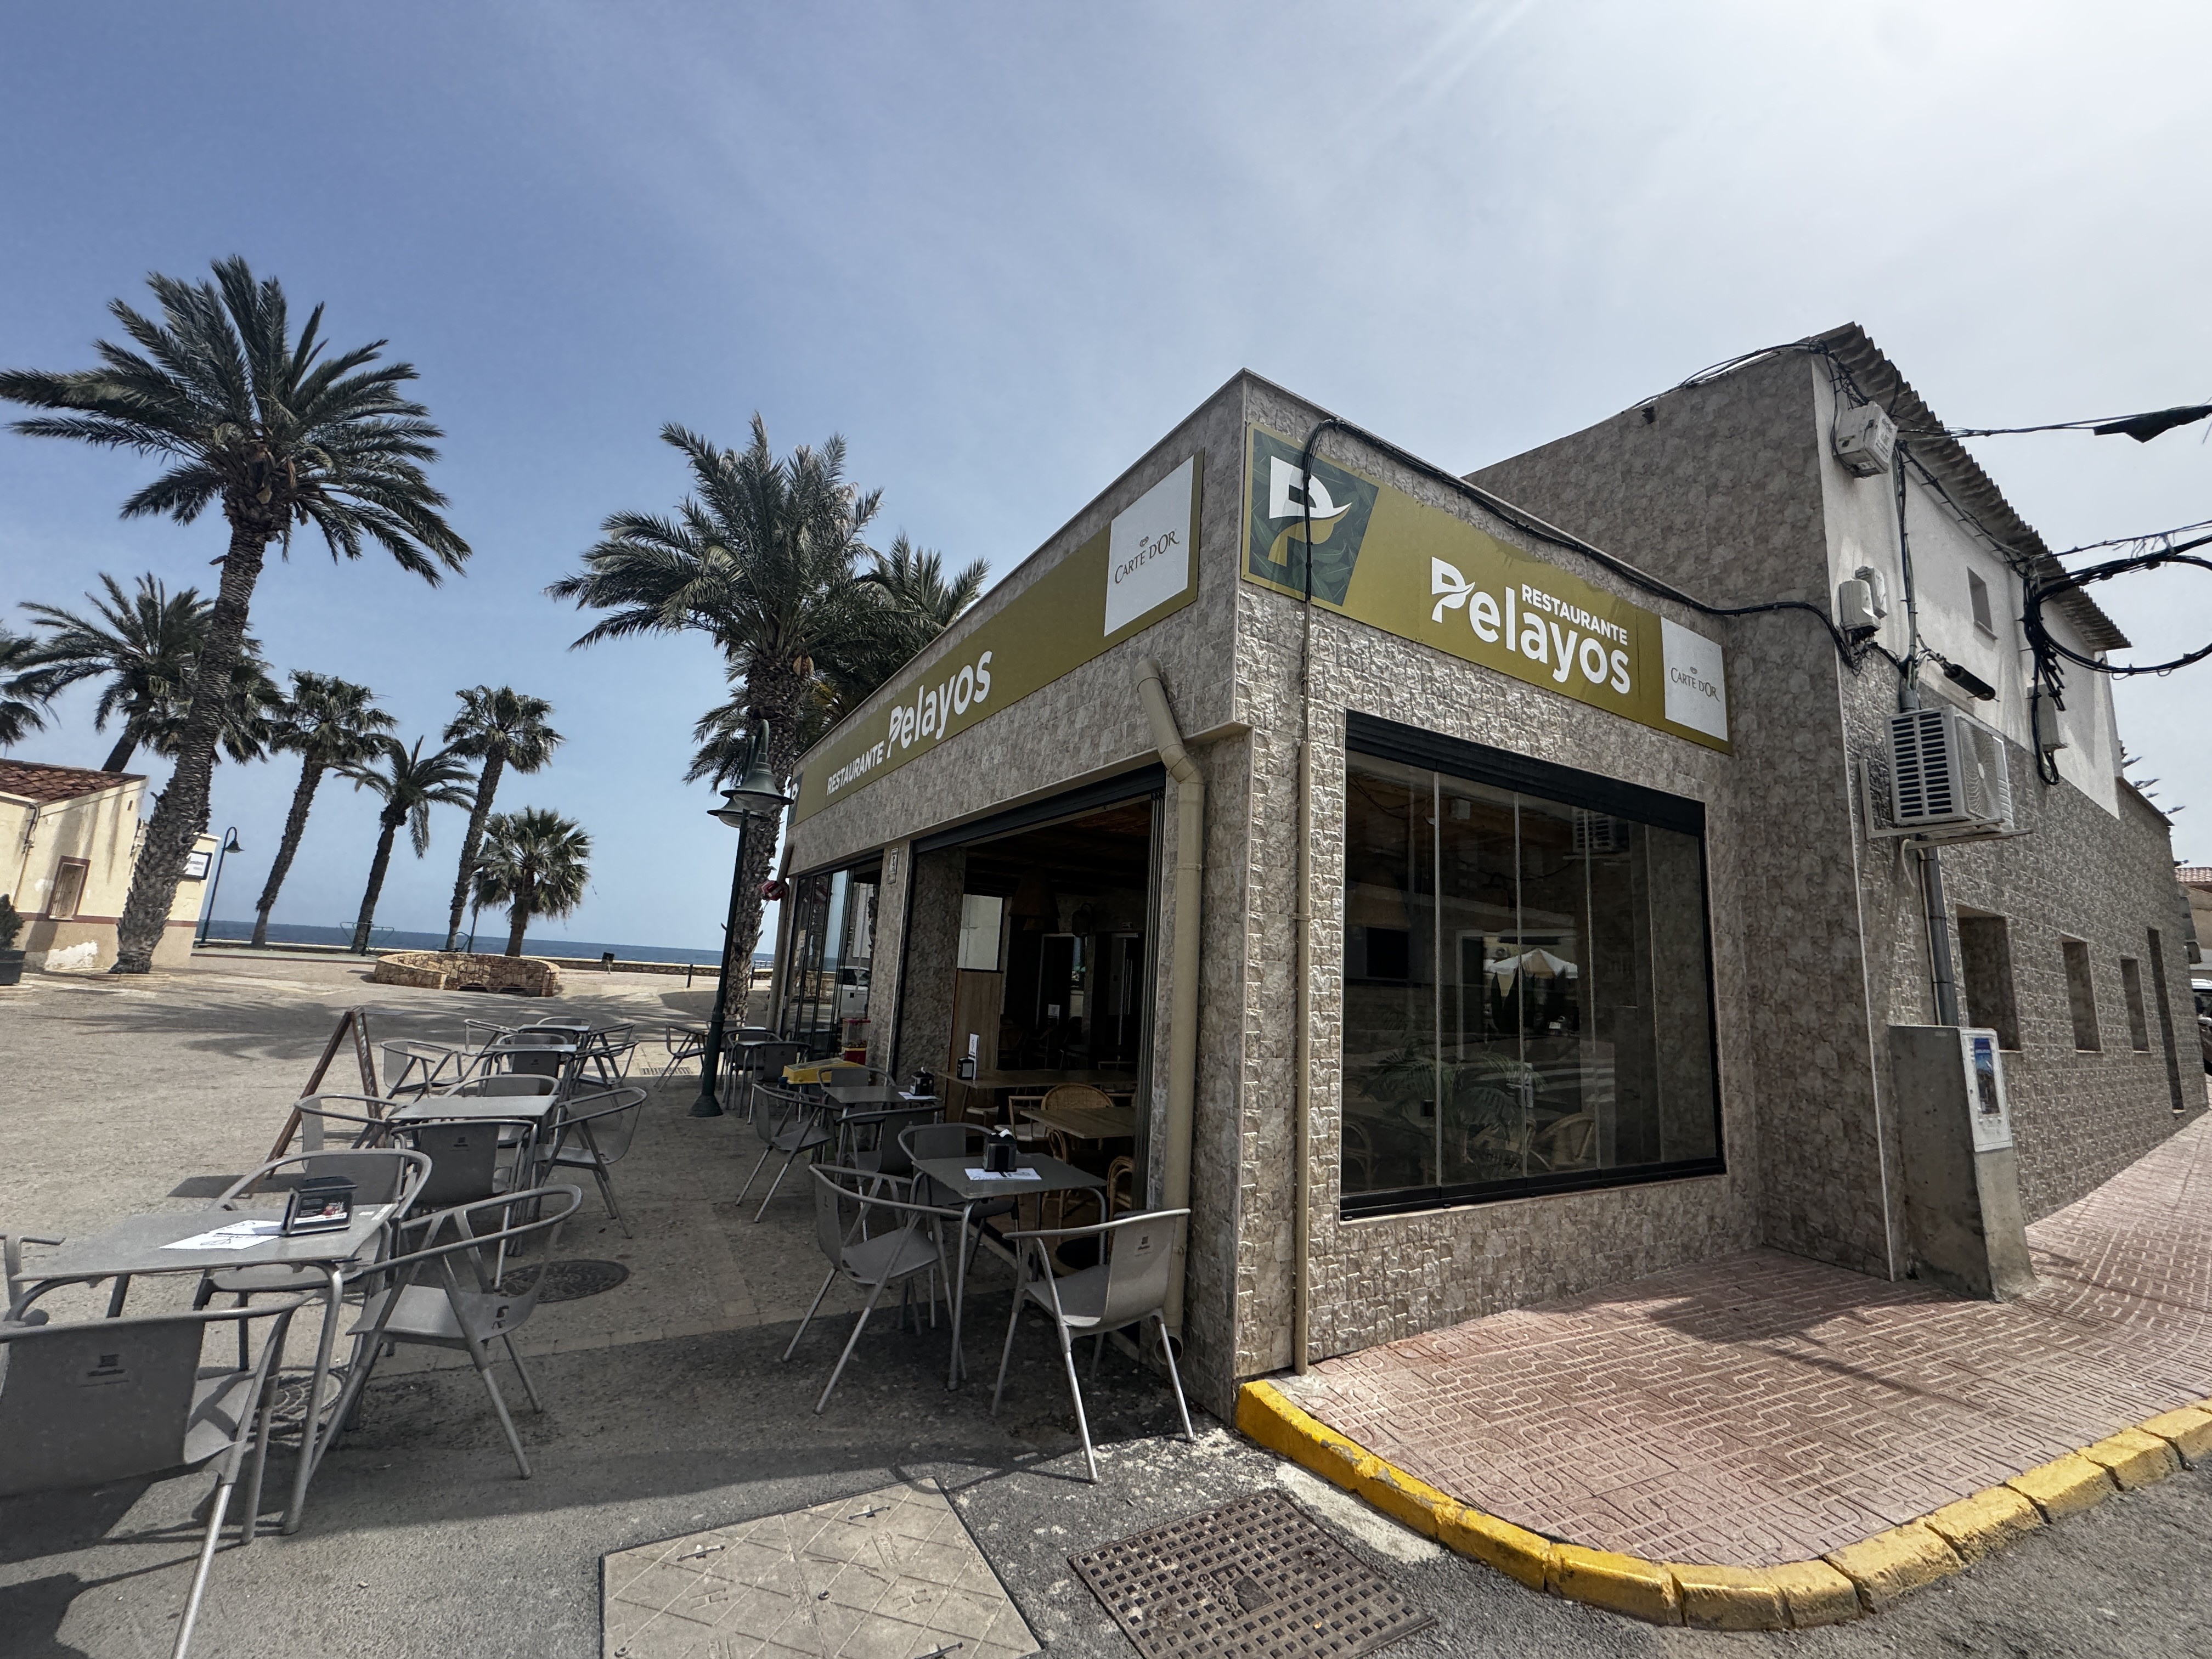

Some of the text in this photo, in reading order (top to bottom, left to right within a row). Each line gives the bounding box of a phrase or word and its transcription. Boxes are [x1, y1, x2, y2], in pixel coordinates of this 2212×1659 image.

[1115, 530, 1181, 584] CARTE D'OR
[1431, 556, 1630, 695] Pelayos
[1521, 583, 1628, 646] RESTAURANTE
[1671, 667, 1720, 702] CARTE D'OR
[826, 651, 992, 796] RESTAURANTE Pelayos
